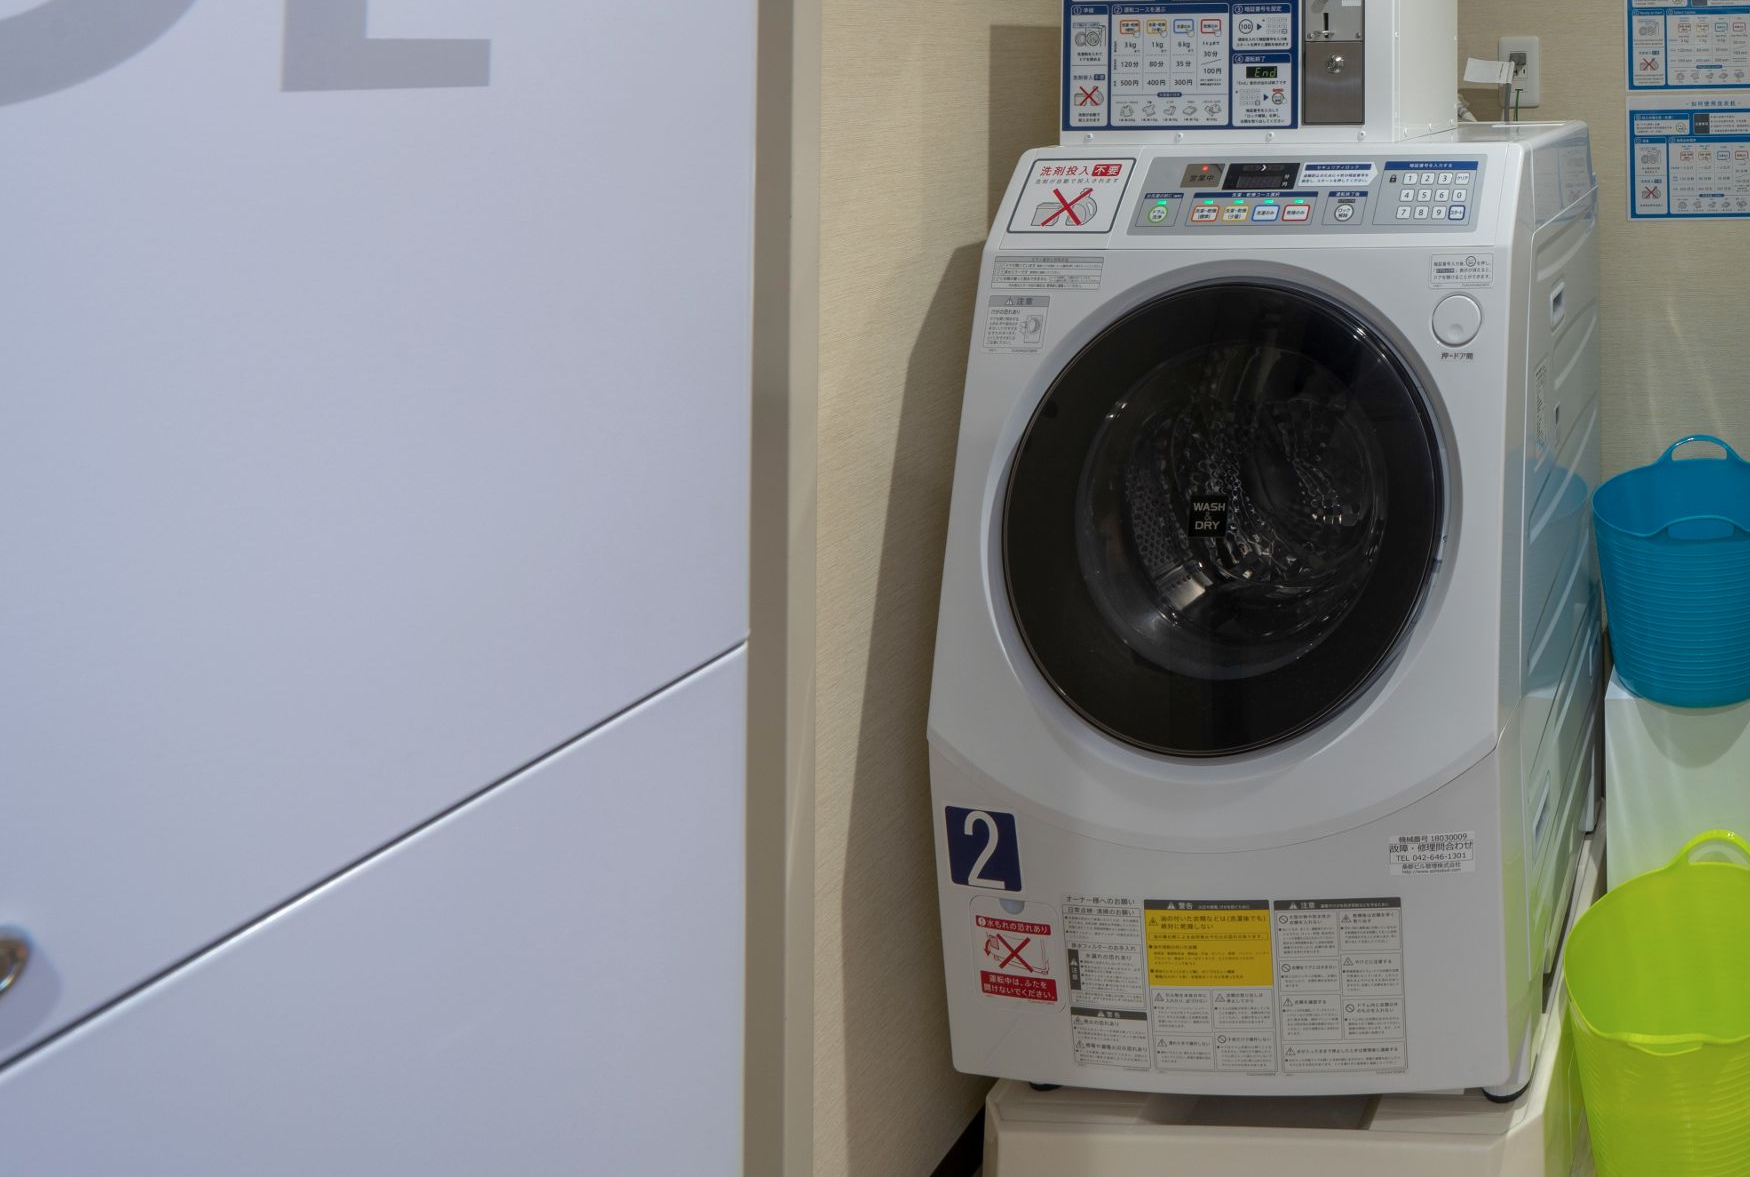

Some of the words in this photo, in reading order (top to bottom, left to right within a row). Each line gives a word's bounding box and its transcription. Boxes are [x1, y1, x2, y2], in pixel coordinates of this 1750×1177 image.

[1040, 166, 1089, 176] 洗剤投入
[1095, 165, 1121, 176] 不要
[1194, 503, 1225, 511] WASH
[1205, 512, 1211, 521] &
[1195, 522, 1219, 530] DRY
[1431, 833, 1467, 841] 18030009
[964, 810, 1005, 889] 2
[1413, 852, 1466, 861] 042-646-1301
[987, 918, 1048, 934] 水もれの恐れあり
[984, 983, 1054, 999] 開けないでください。
